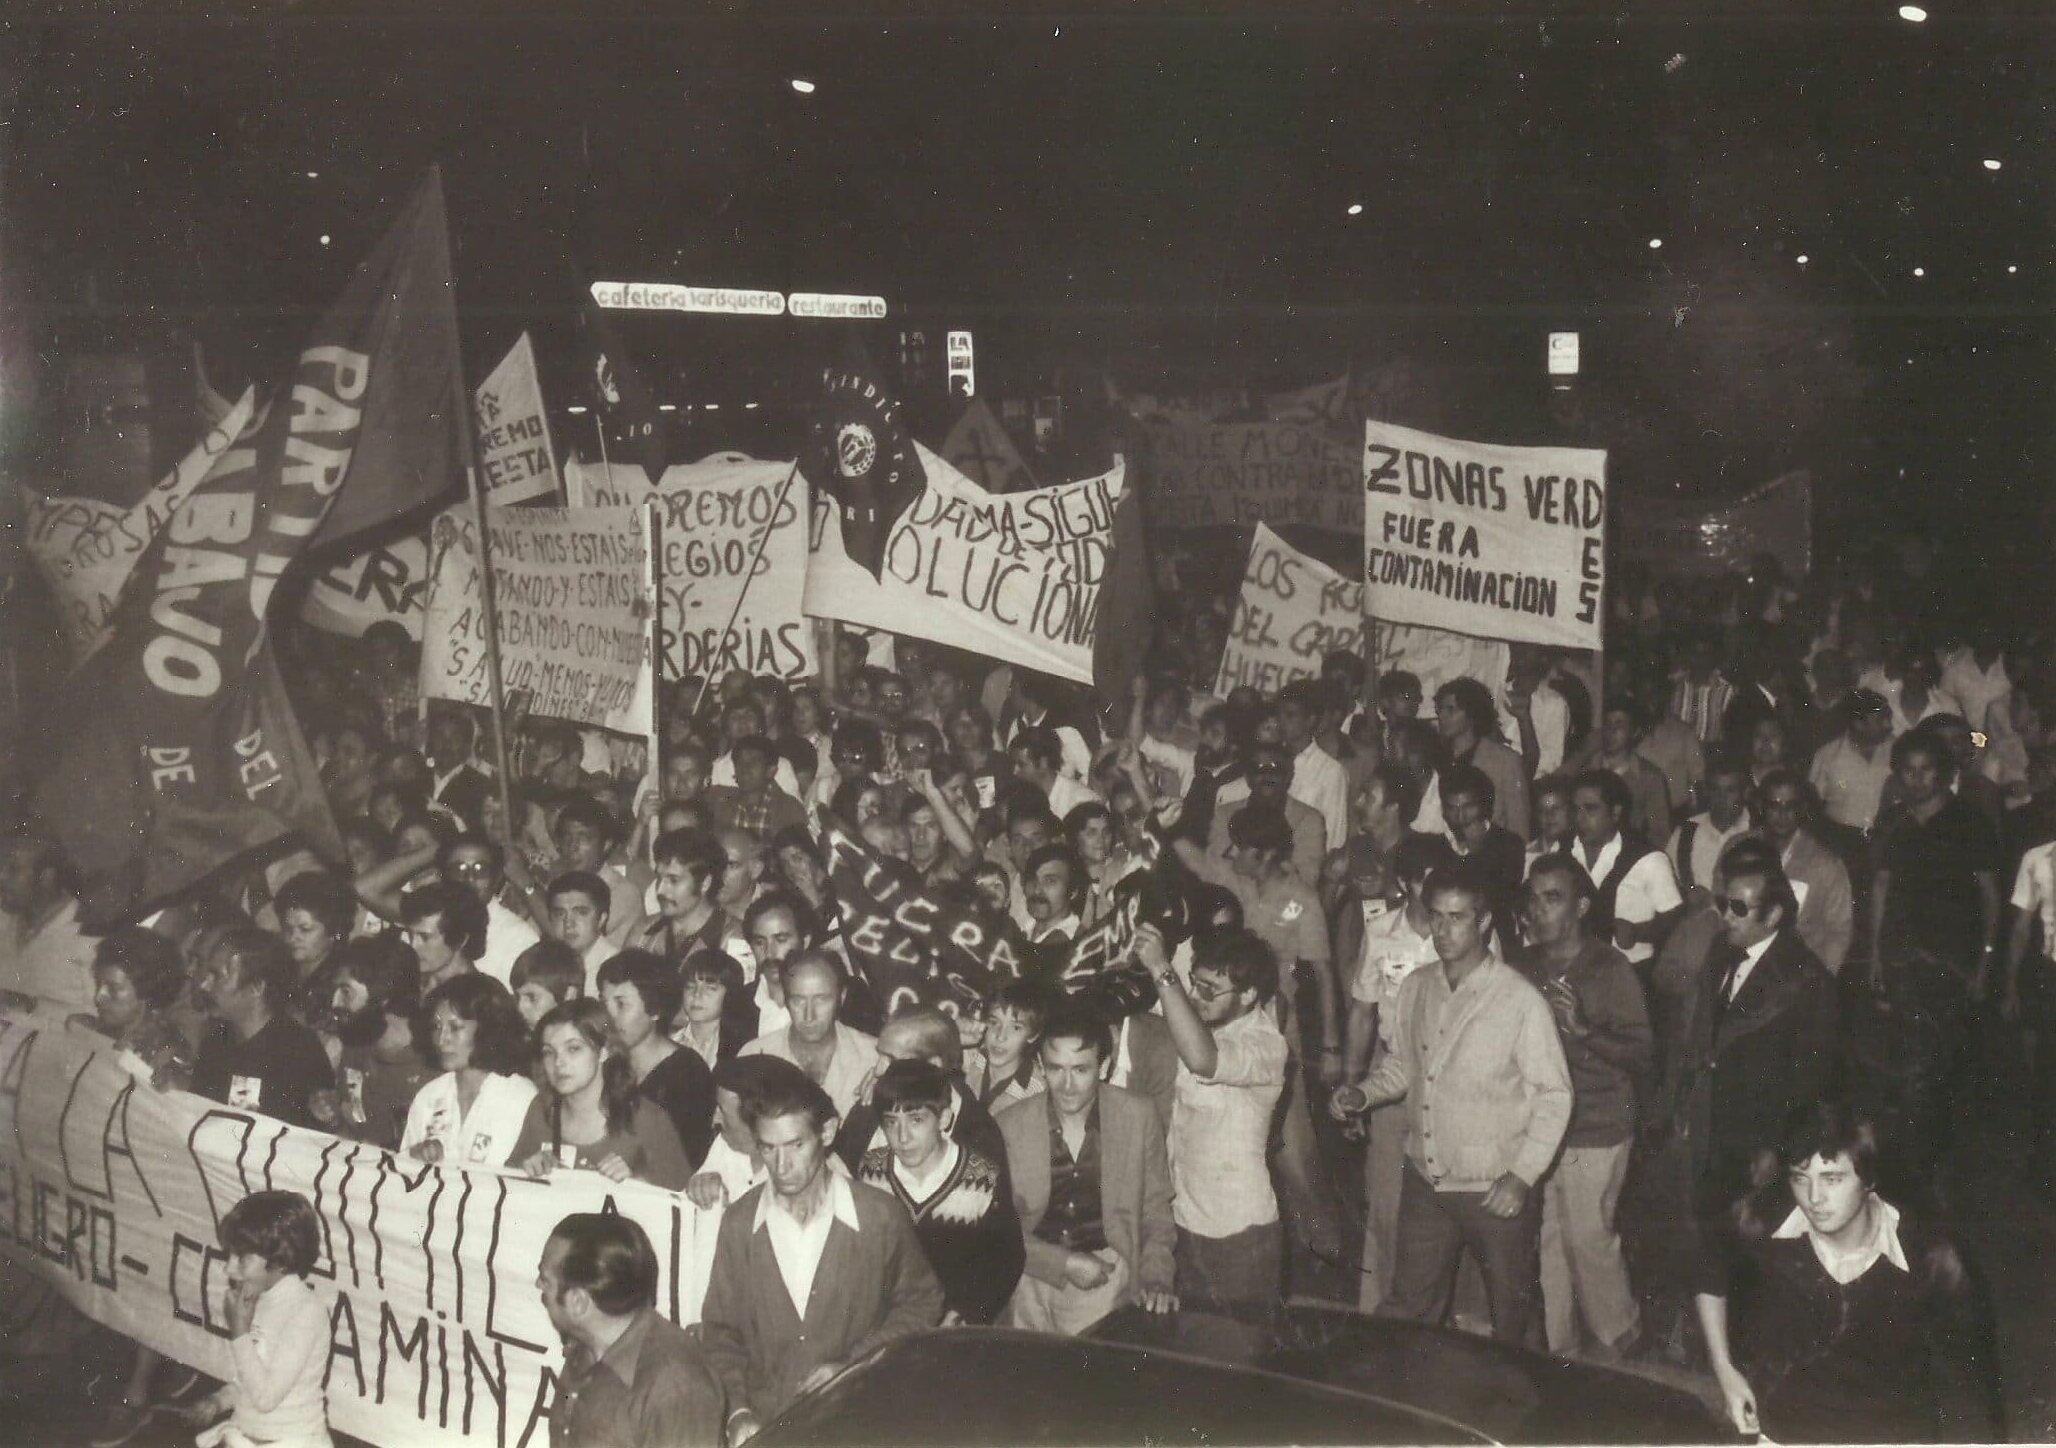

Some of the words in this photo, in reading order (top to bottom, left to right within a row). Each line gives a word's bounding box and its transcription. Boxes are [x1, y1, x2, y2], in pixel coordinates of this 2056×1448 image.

[598, 284, 686, 307] cafeteria
[793, 297, 884, 317] restaurante
[1366, 443, 1507, 512] ZONAS
[1383, 510, 1480, 559] FUERA
[1245, 541, 1302, 600] LOS
[1367, 547, 1557, 618] CONTAMINACION
[1230, 591, 1279, 648] DEL
[149, 746, 196, 790] DE
[233, 730, 283, 800] DEL
[59, 1051, 164, 1218] LA
